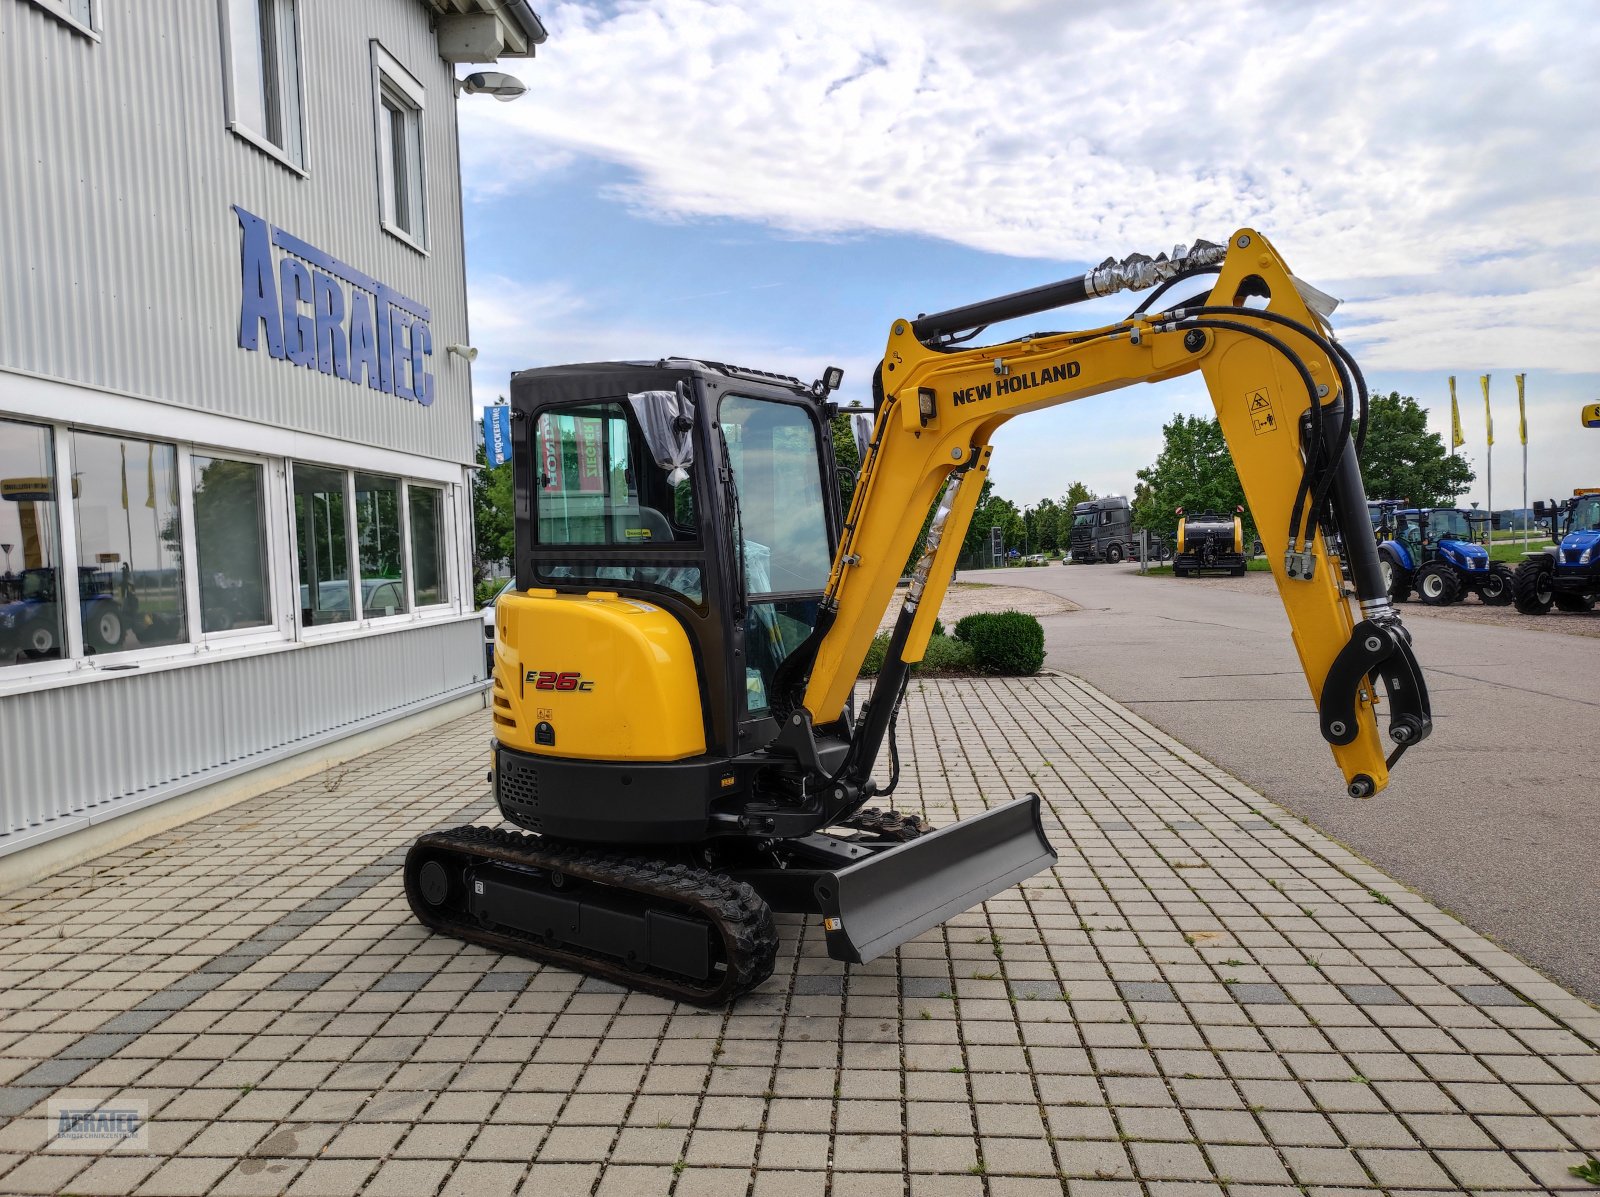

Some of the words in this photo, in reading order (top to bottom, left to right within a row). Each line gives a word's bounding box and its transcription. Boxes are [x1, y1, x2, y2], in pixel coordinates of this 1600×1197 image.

[232, 204, 434, 407] AGRATEC
[953, 382, 992, 406] NEW
[996, 361, 1081, 396] HOLLAND
